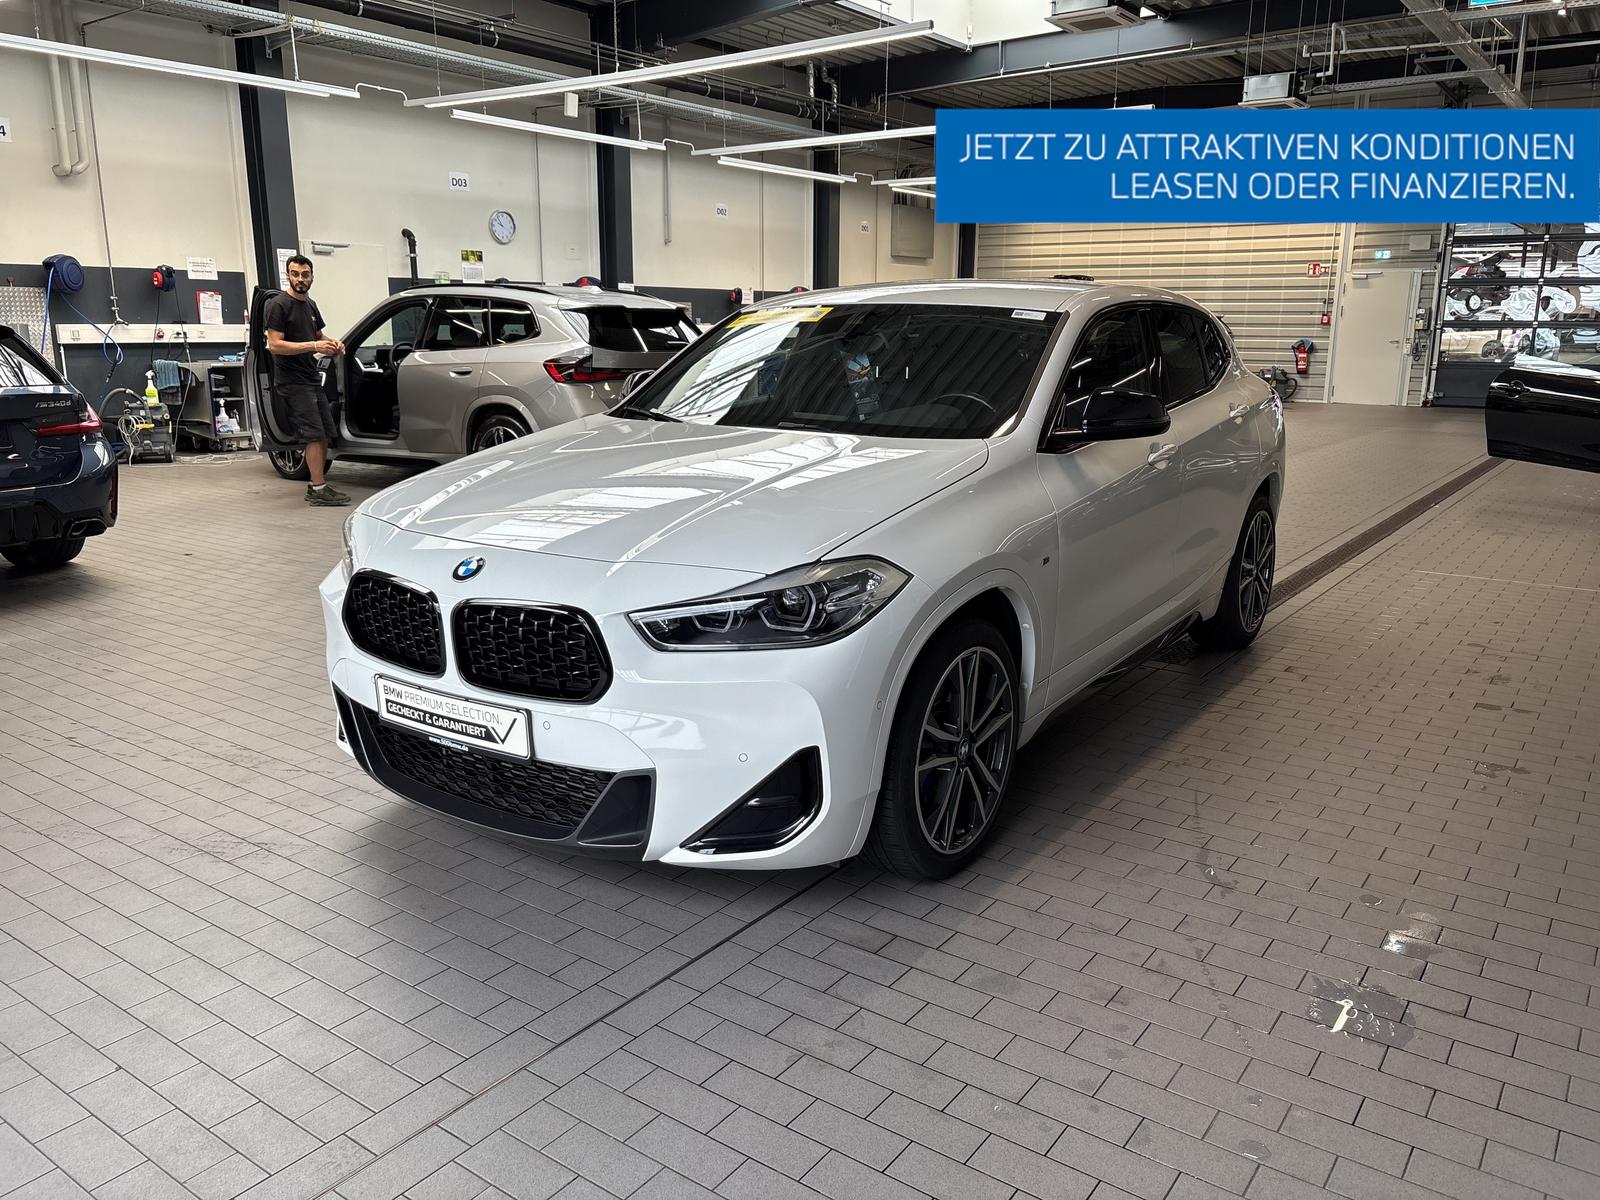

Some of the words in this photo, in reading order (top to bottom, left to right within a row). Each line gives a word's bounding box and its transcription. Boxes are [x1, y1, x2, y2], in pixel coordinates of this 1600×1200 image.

[451, 177, 468, 188] D03
[716, 207, 727, 217] D02
[383, 684, 403, 700] BMW
[404, 691, 444, 712] PREMIUM
[387, 702, 424, 721] GECHECKT
[425, 714, 433, 723] &
[432, 716, 487, 738] GARANTIERT
